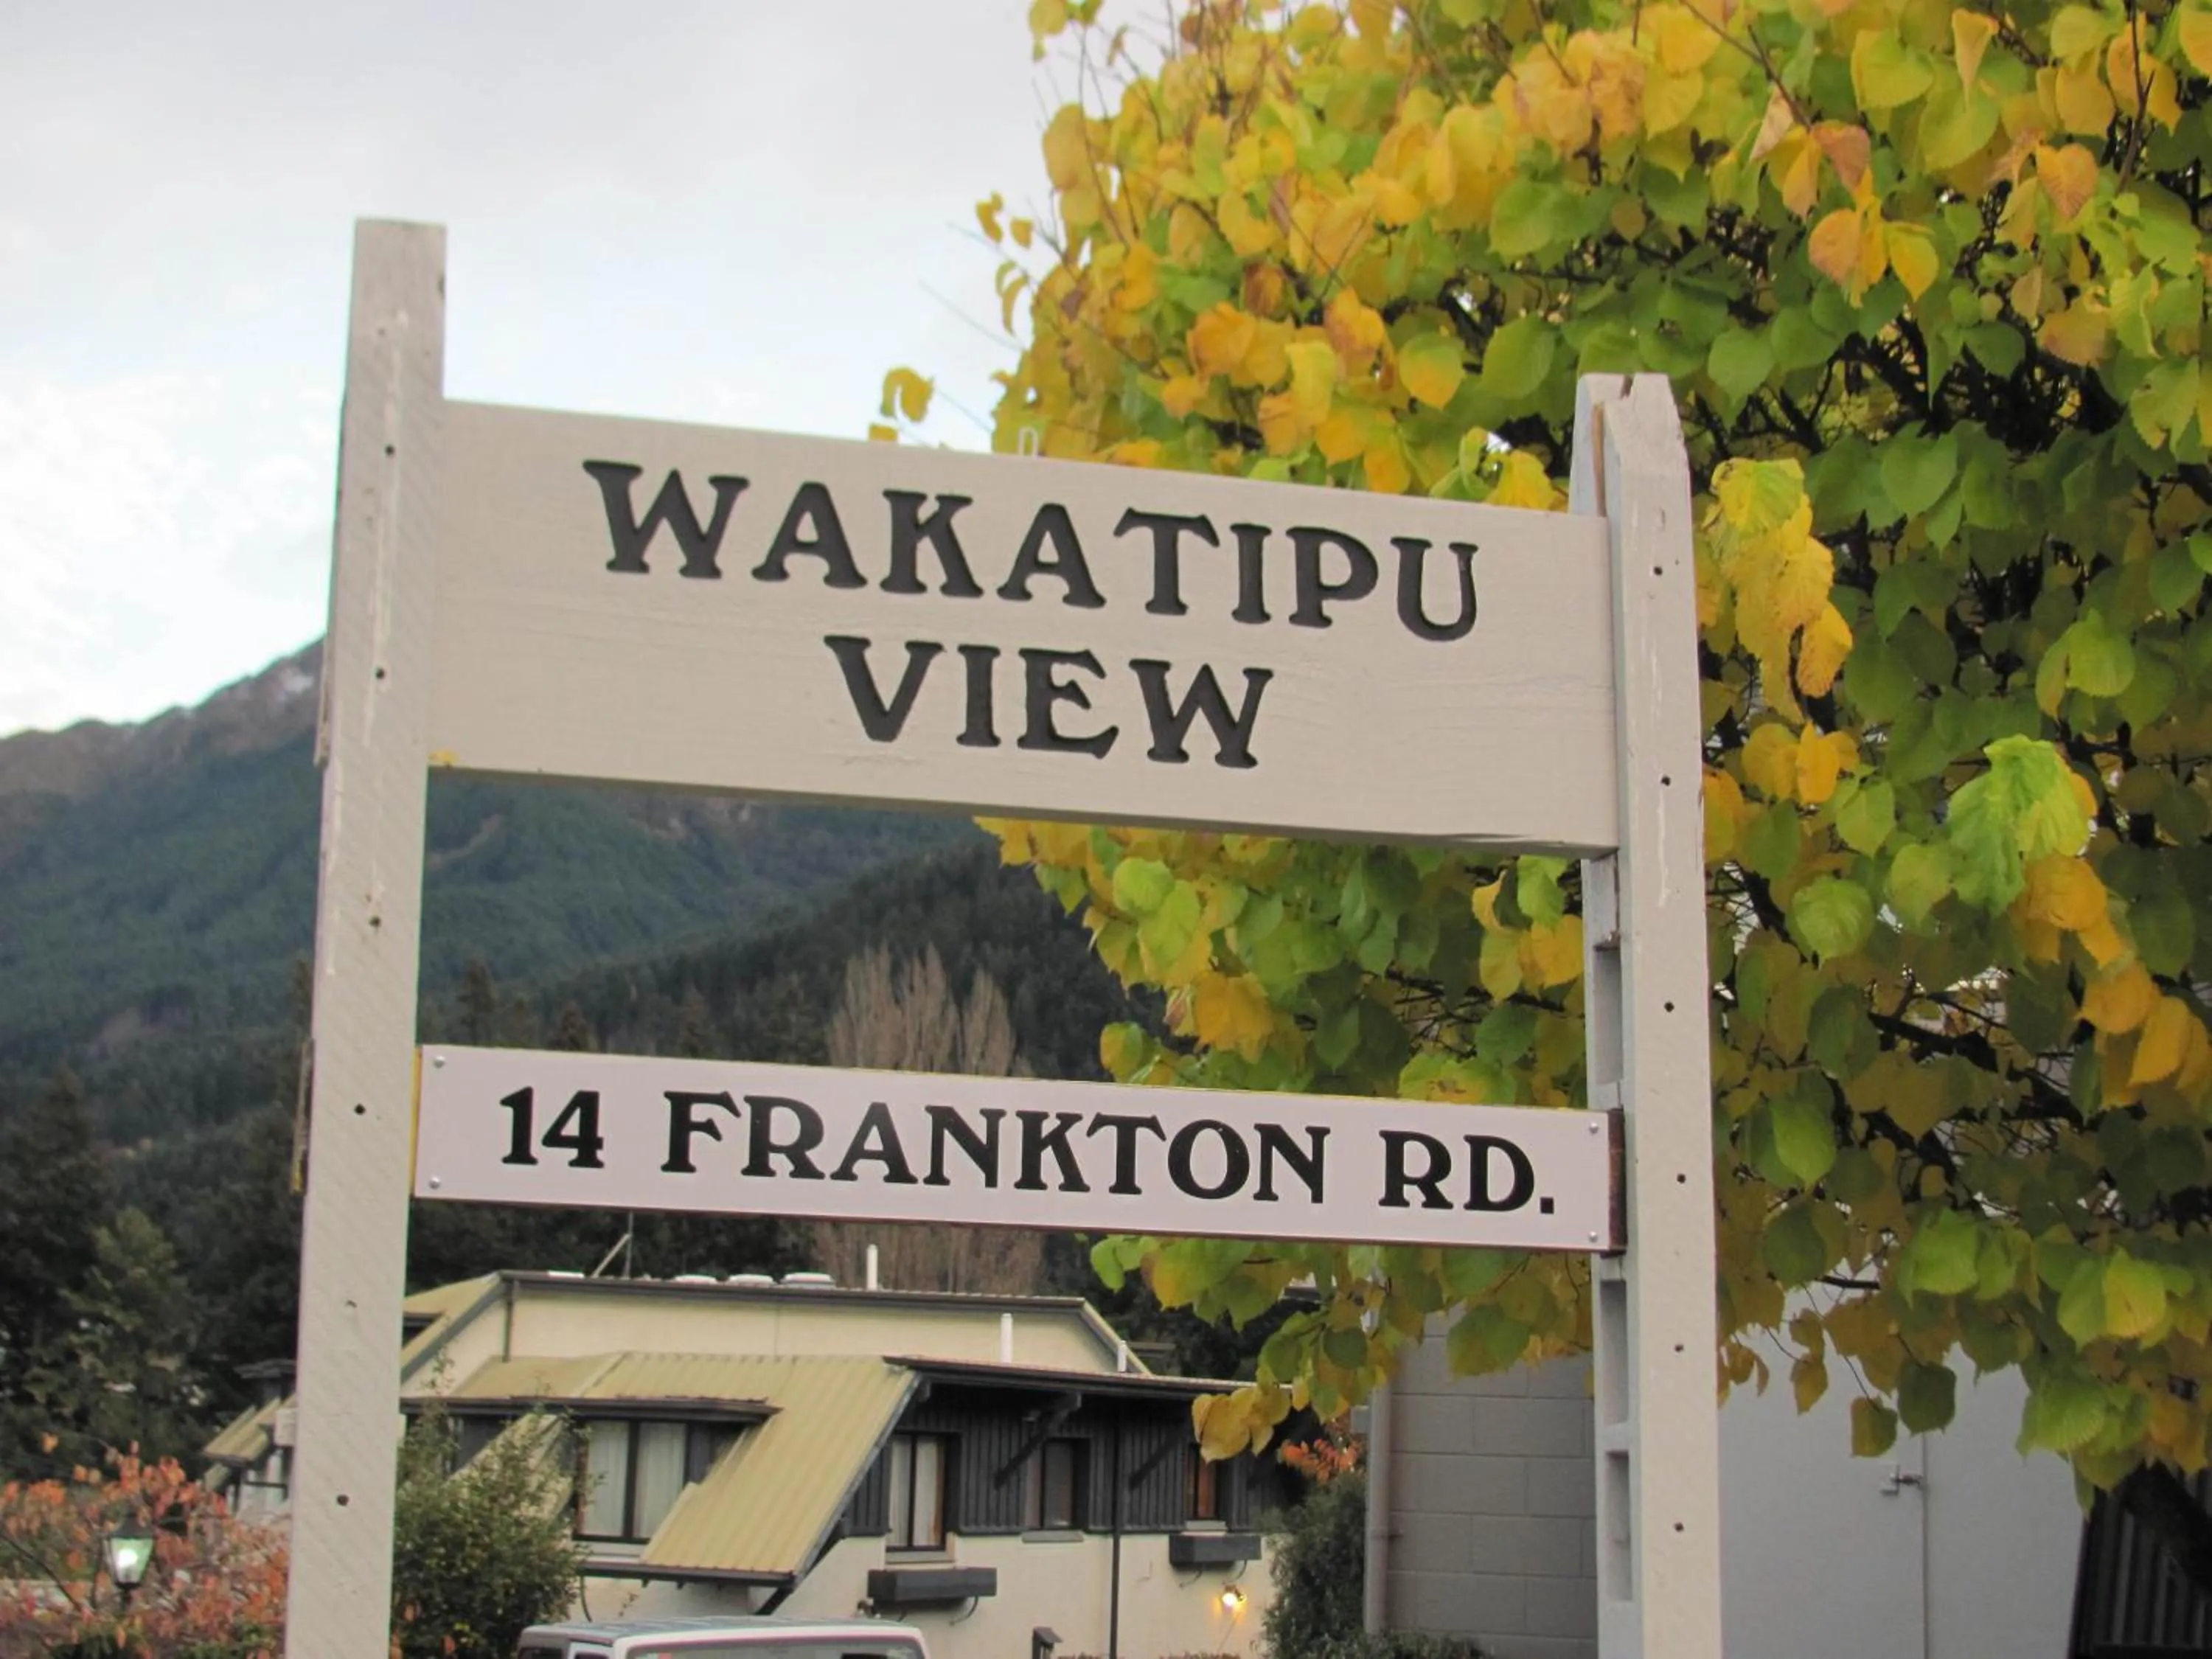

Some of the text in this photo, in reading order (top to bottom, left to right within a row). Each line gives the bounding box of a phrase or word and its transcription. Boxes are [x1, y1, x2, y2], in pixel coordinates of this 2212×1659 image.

[582, 459, 1480, 641] WAKATIPU
[824, 635, 1274, 769] VIEW
[500, 1086, 1554, 1214] 14 FRANKTON RD.
